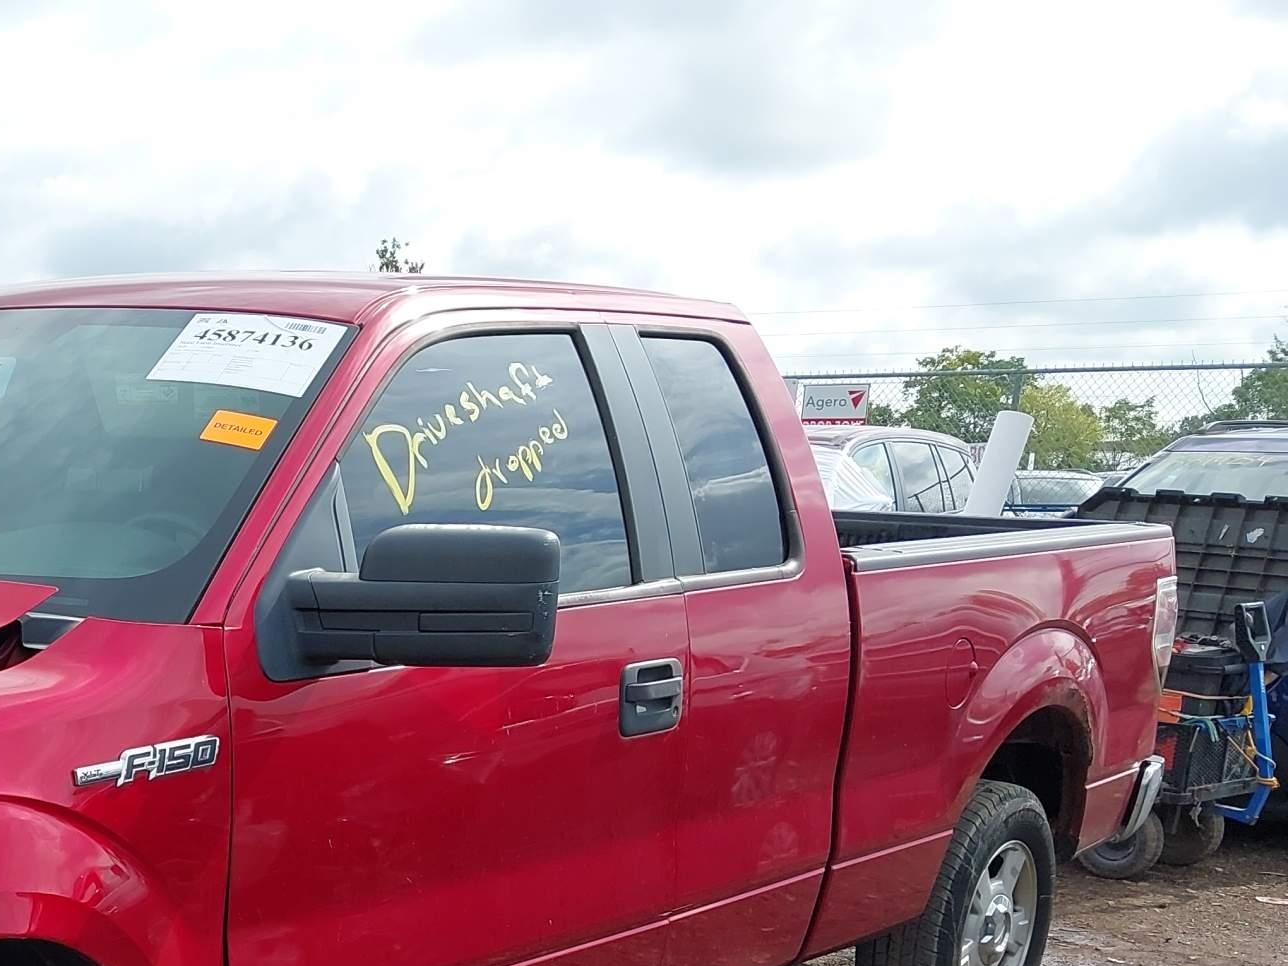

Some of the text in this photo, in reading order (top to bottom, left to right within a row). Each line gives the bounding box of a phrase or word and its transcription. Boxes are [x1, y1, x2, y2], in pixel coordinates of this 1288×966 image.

[194, 328, 315, 351] 45874136
[805, 396, 847, 410] Agero
[214, 422, 263, 436] DETAILED
[363, 362, 553, 516] Driveshaft
[475, 408, 569, 511] dropped
